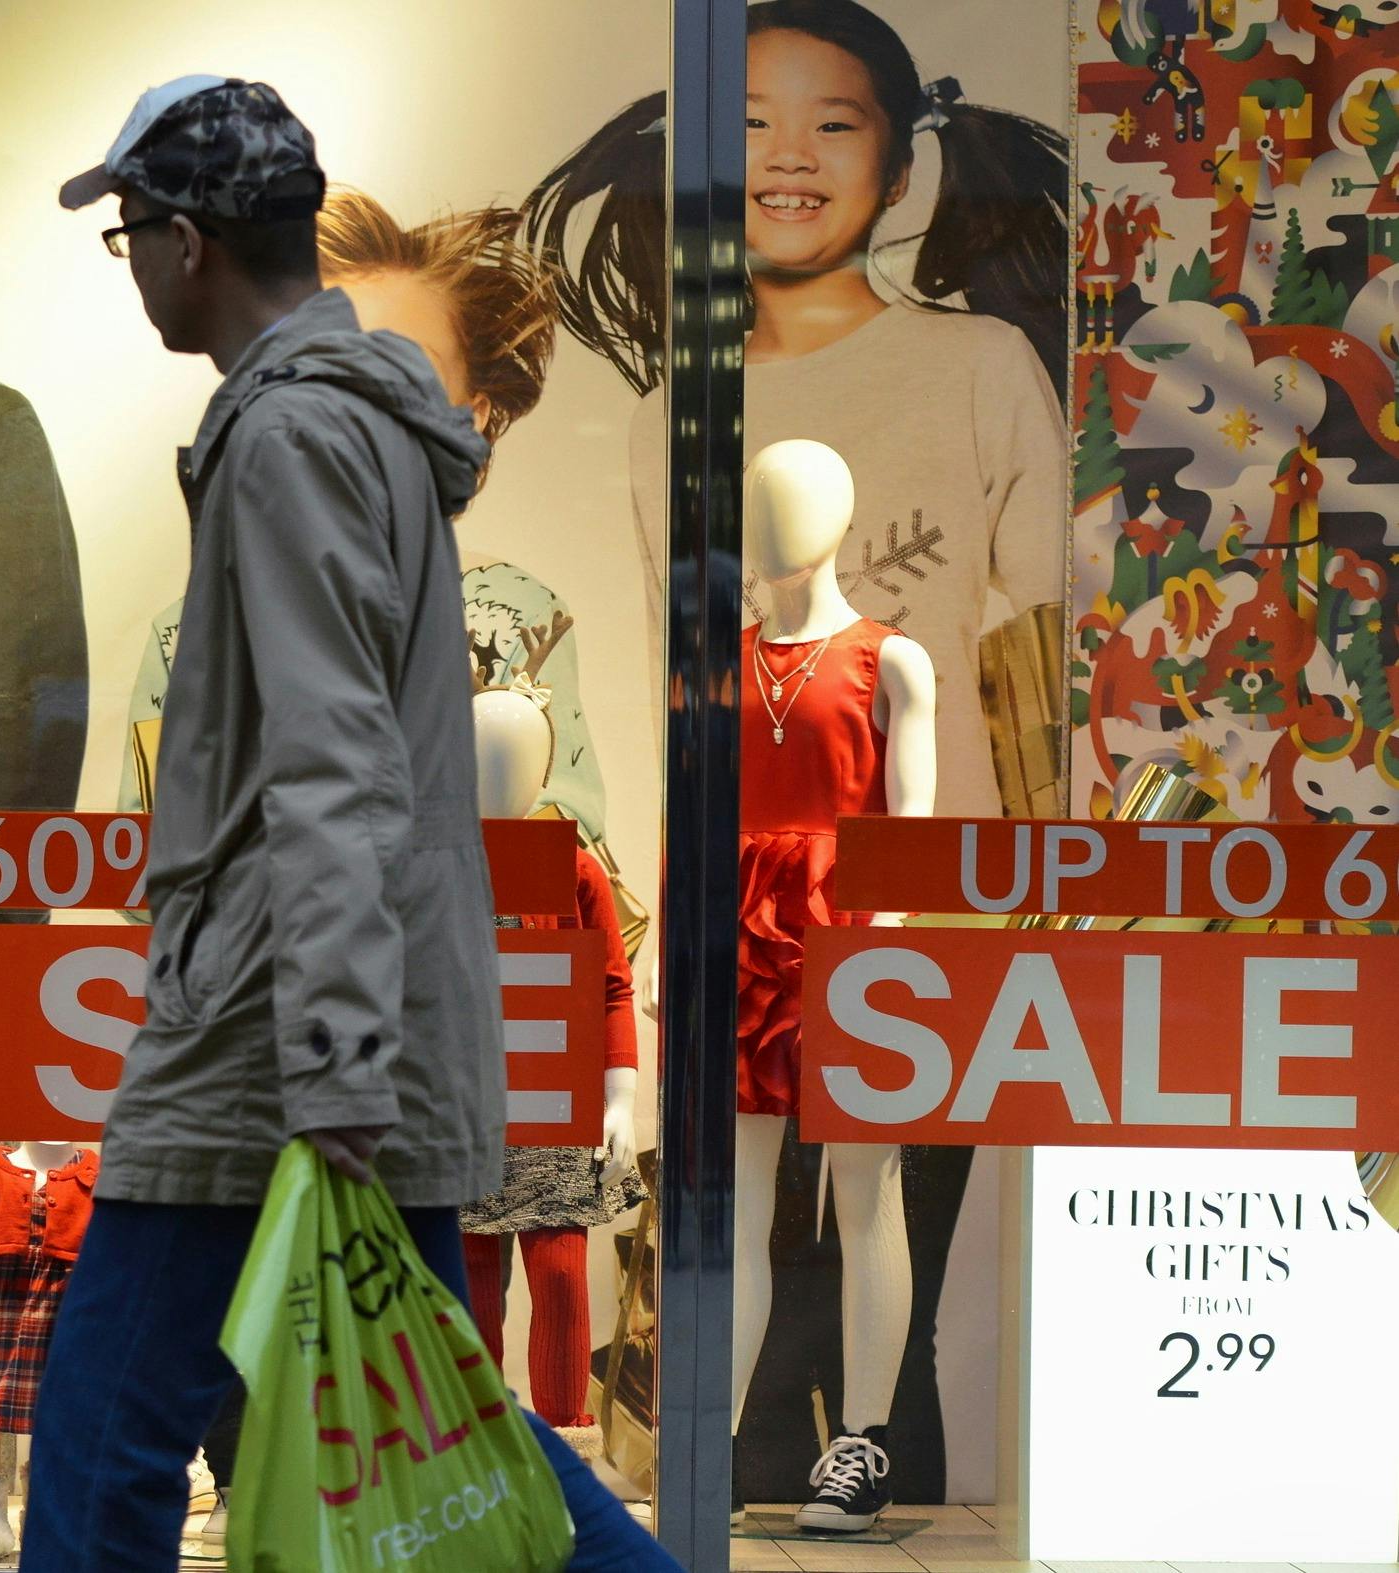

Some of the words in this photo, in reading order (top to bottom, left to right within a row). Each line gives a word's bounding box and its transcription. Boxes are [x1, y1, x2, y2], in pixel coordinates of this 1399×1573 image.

[960, 823, 1108, 914] UP
[1139, 827, 1288, 918] TO
[1324, 830, 1399, 920] 6
[821, 947, 1359, 1129] SALE
[1068, 1188, 1371, 1233] CHRISTMAS
[1145, 1243, 1291, 1283] GIFTS
[1182, 1296, 1253, 1317] FROM
[1157, 1331, 1276, 1399] 2.99
[313, 1312, 507, 1506] SALE
